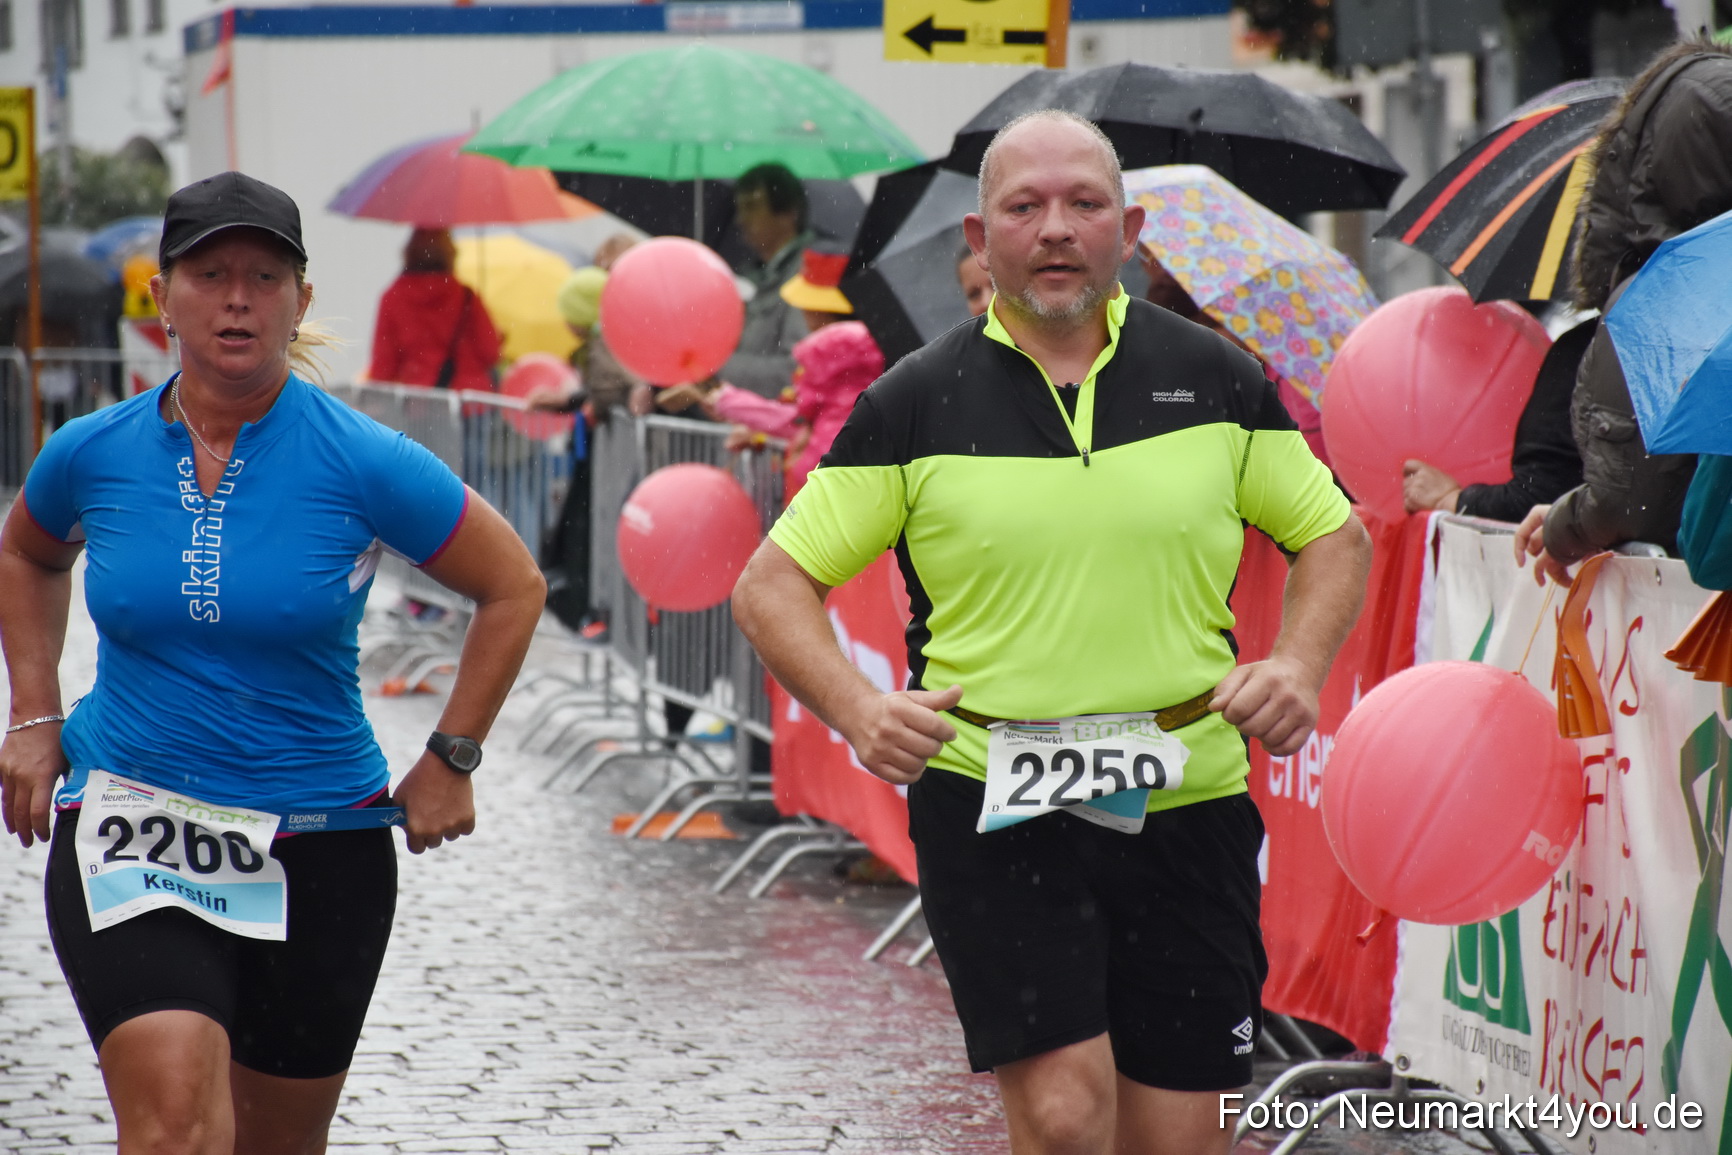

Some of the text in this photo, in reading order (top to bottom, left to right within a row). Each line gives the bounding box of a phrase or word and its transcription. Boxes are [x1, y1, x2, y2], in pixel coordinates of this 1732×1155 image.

[176, 456, 245, 623] skinfit
[1074, 717, 1165, 742] BOCK
[288, 813, 328, 825] ERDINGER
[991, 804, 1000, 813] D
[1521, 829, 1564, 867] RO
[89, 864, 98, 875] D
[143, 872, 228, 913] Kerstin
